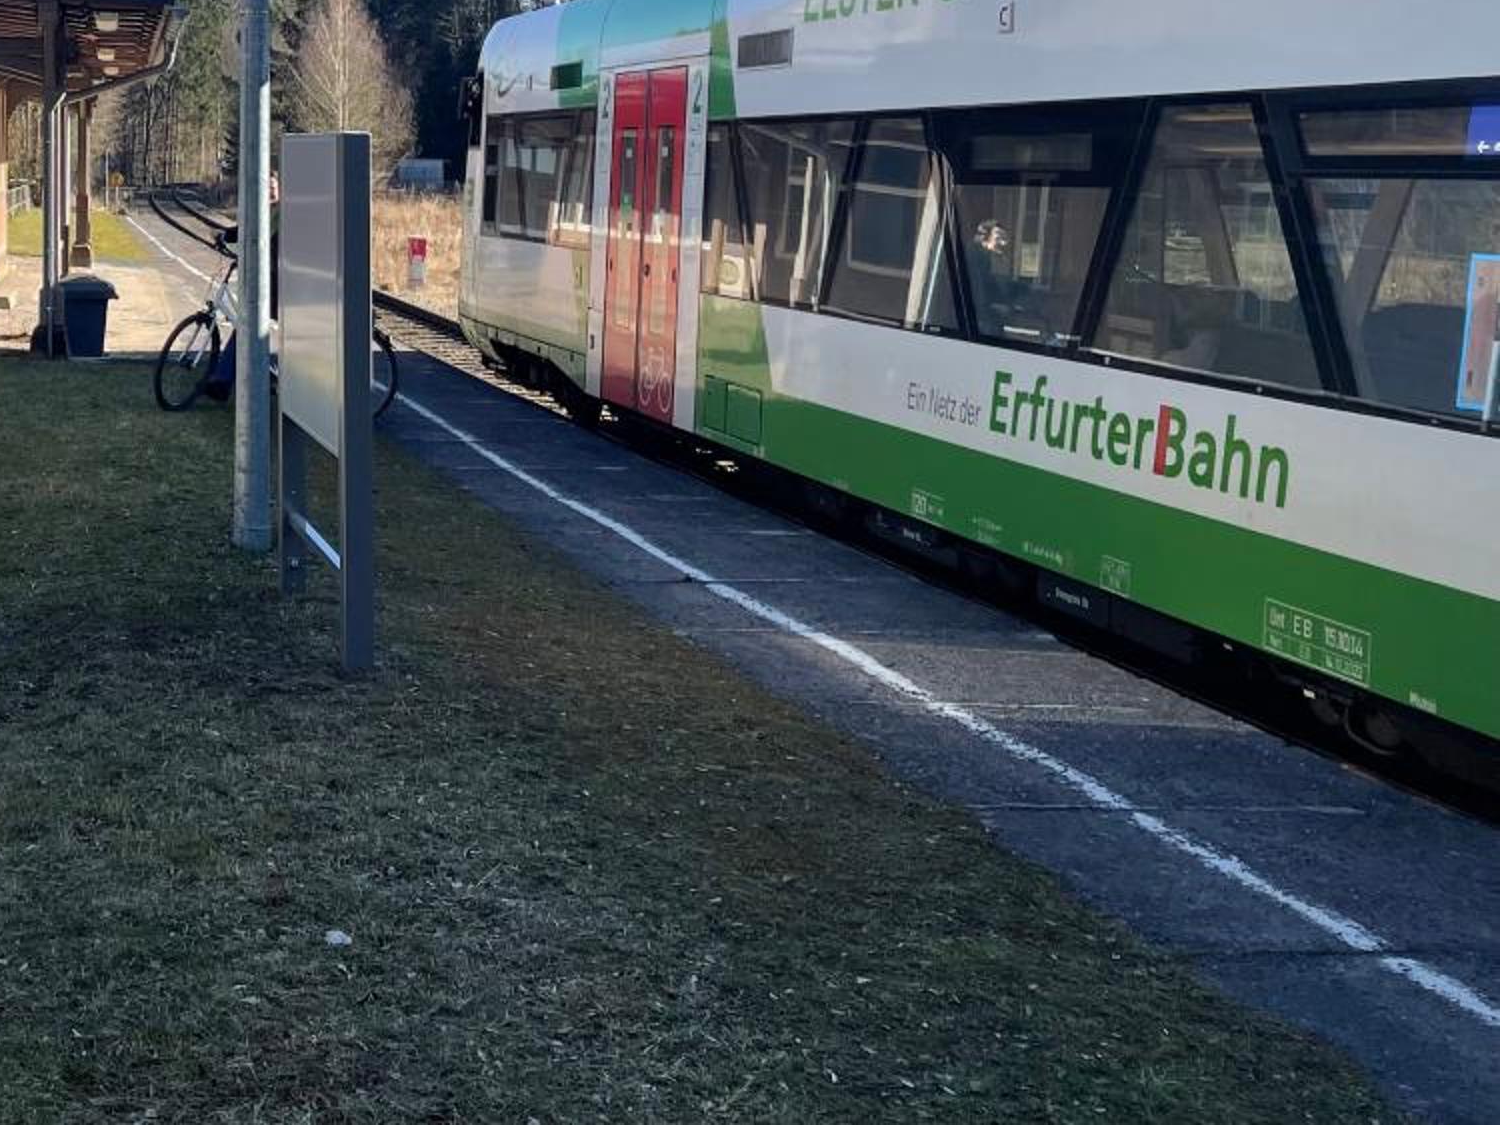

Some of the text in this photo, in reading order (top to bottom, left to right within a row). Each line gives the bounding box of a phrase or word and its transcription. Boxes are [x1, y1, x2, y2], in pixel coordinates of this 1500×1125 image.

[907, 381, 982, 426] Ein Netz der
[989, 369, 1290, 509] ErfurterBahn
